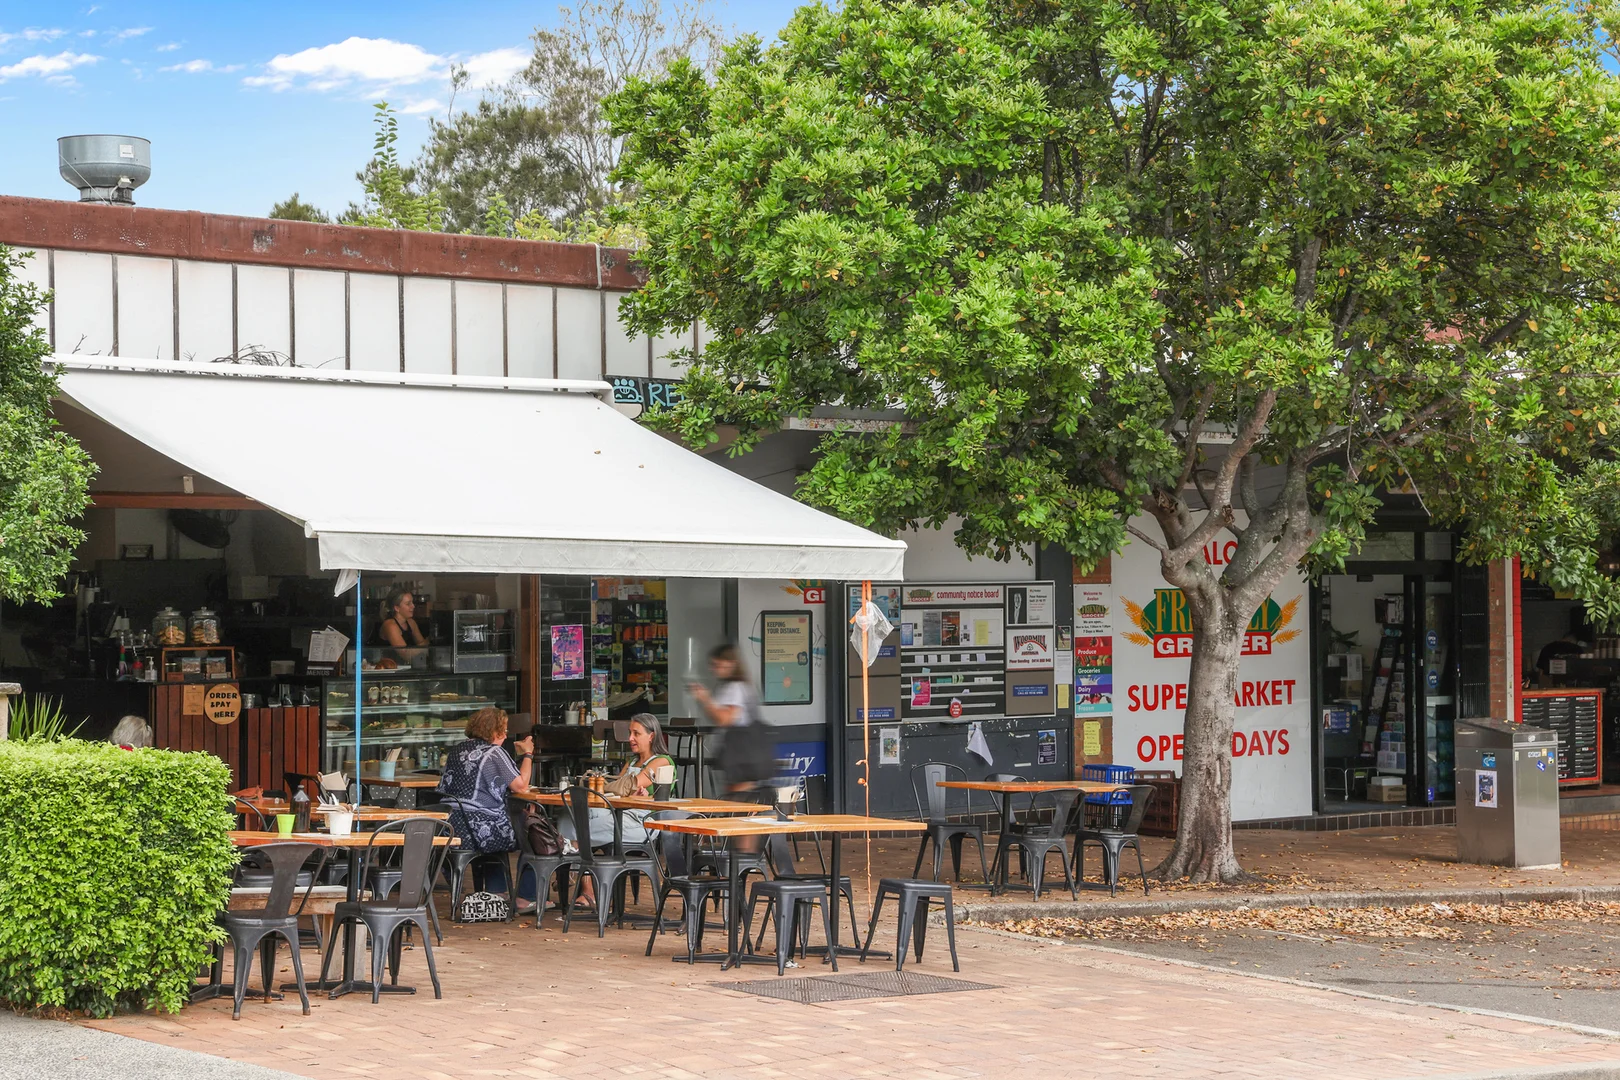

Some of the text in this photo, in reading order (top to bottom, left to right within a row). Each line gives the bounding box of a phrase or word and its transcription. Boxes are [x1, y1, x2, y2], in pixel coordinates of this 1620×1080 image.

[648, 383, 685, 407] RE
[1203, 541, 1239, 565] ALO
[936, 588, 999, 601] community notice board
[1155, 589, 1271, 633] FRILY
[1013, 635, 1048, 653] WOODMILL
[1156, 635, 1269, 655] GRER
[1127, 680, 1296, 712] SUPEARKET
[1136, 729, 1290, 763] OPE DAYS
